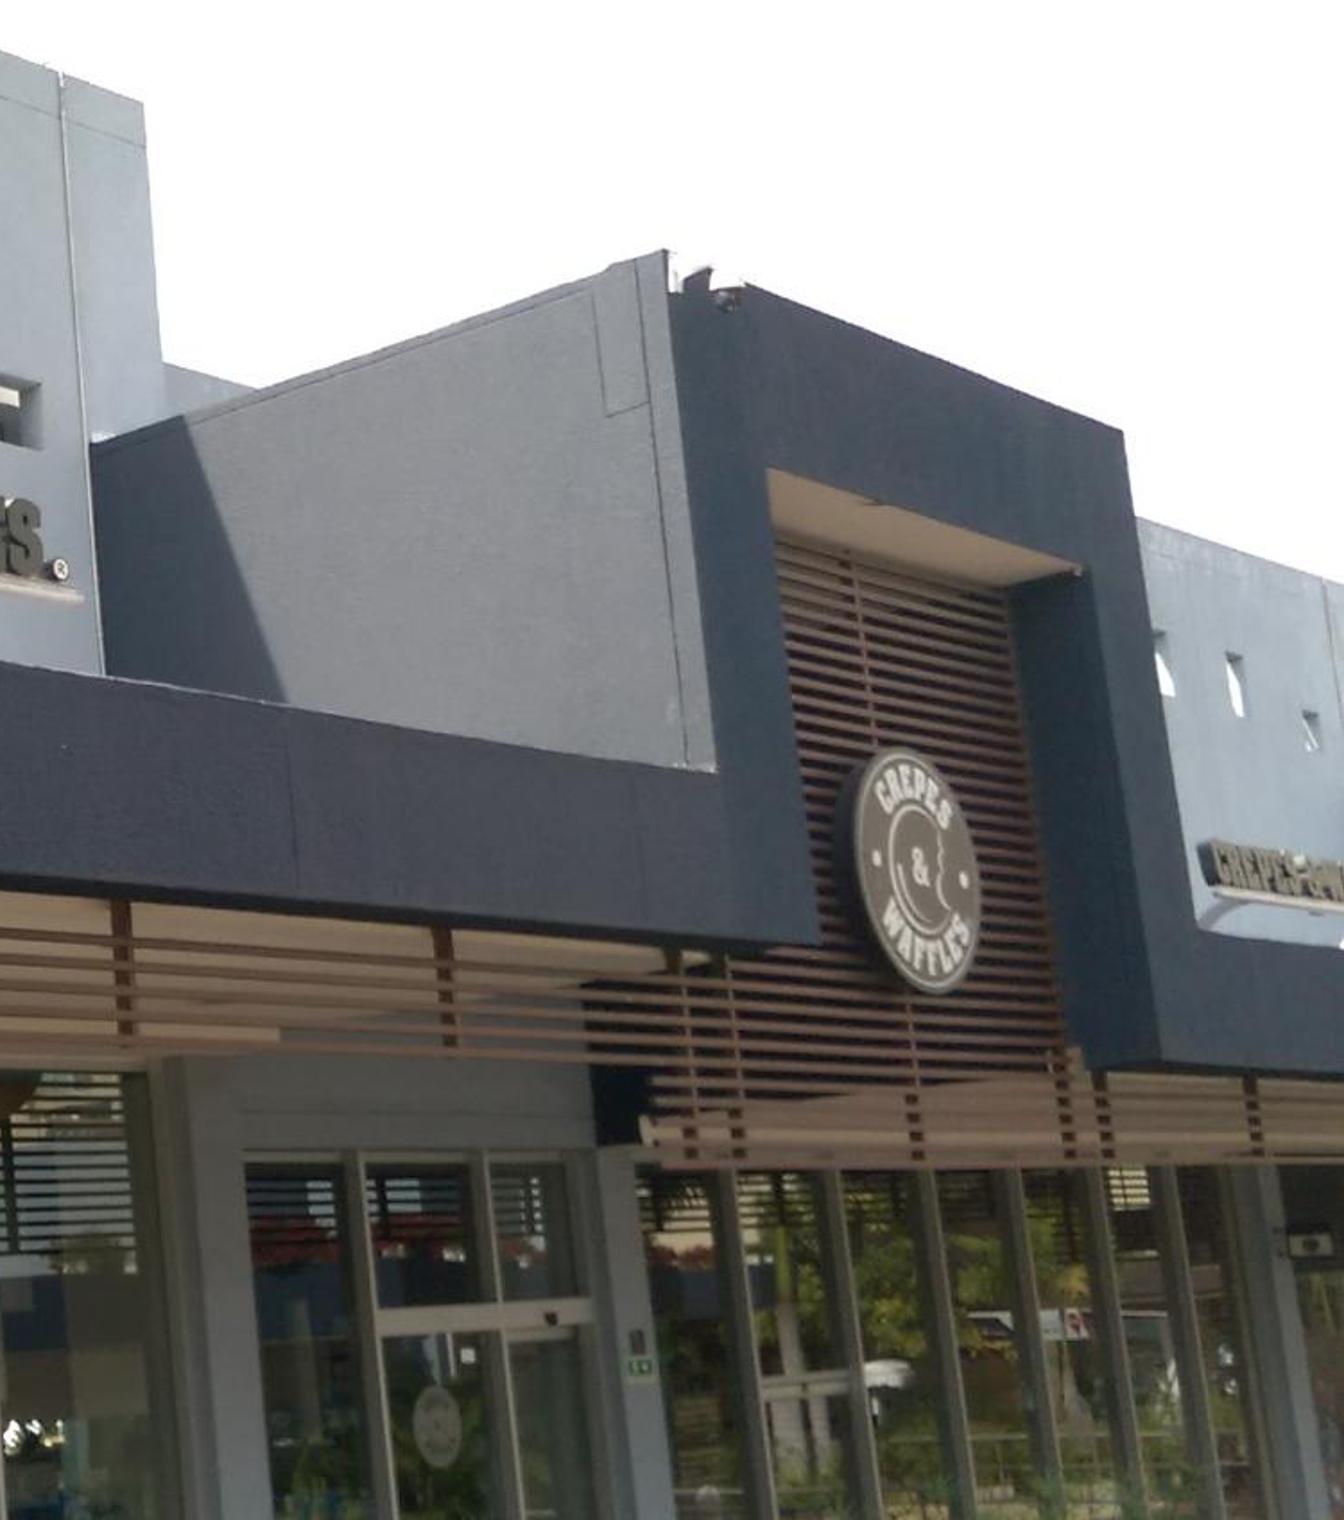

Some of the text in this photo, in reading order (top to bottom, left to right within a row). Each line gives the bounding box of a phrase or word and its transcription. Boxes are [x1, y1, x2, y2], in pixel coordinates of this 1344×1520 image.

[875, 763, 953, 830] CREPES
[911, 846, 931, 888] &
[883, 894, 970, 977] WAFFLES
